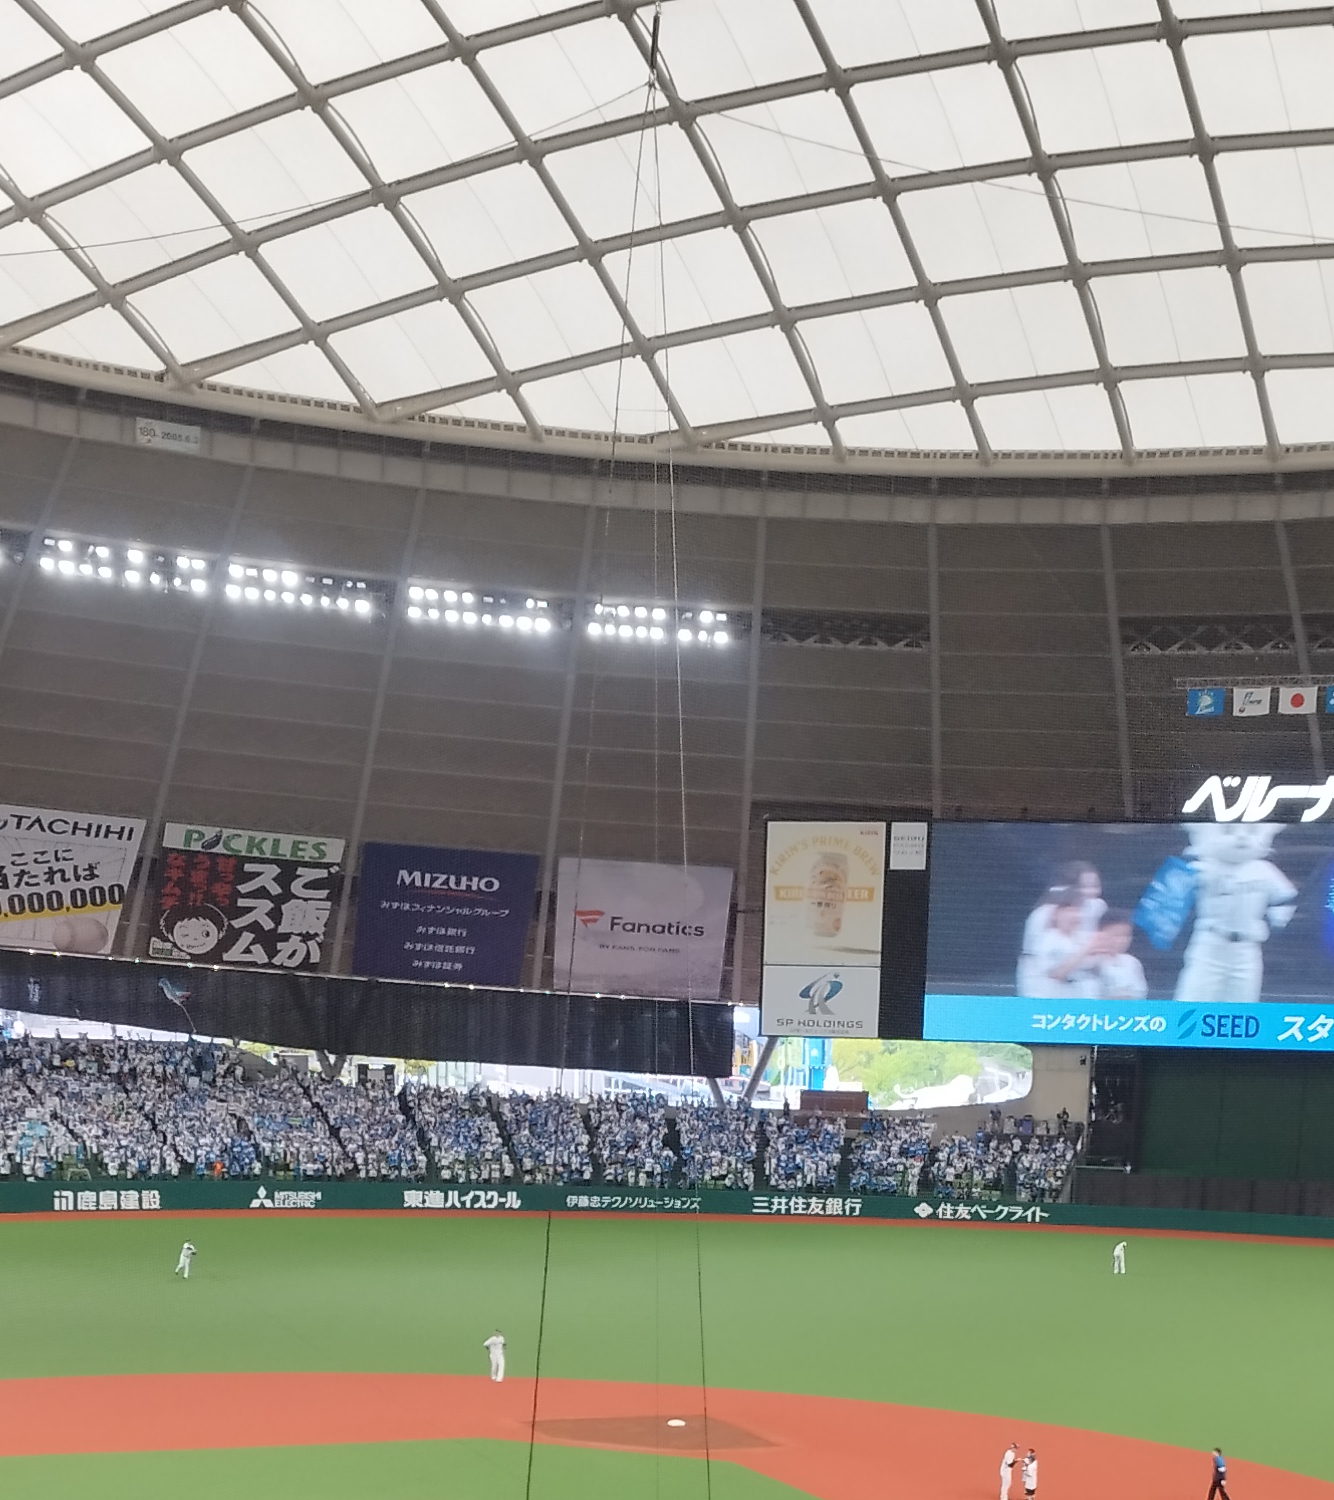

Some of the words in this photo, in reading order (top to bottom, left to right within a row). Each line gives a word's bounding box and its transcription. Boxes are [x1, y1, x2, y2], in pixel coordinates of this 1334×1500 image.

[10, 813, 135, 841] TACHIHI
[11, 849, 75, 866] ここに
[812, 835, 850, 850] PRIME
[853, 846, 881, 877] BREW
[396, 869, 500, 892] MIZUHO
[222, 863, 282, 965] ススム
[609, 915, 705, 937] Fanatics
[776, 1018, 794, 1027] SP
[797, 1019, 864, 1029] HOLDINGS
[1030, 1012, 1167, 1034] コンタクトレンズの
[1200, 1013, 1260, 1039] SEED
[77, 1190, 161, 1211] 鹿島建設
[404, 1190, 521, 1209] 東進ハイスクール
[566, 1194, 701, 1210] 伊藤忠テクノソリューションズ
[752, 1196, 863, 1216] 三井住友銀行
[936, 1201, 1050, 1223] 住友ベークライト
